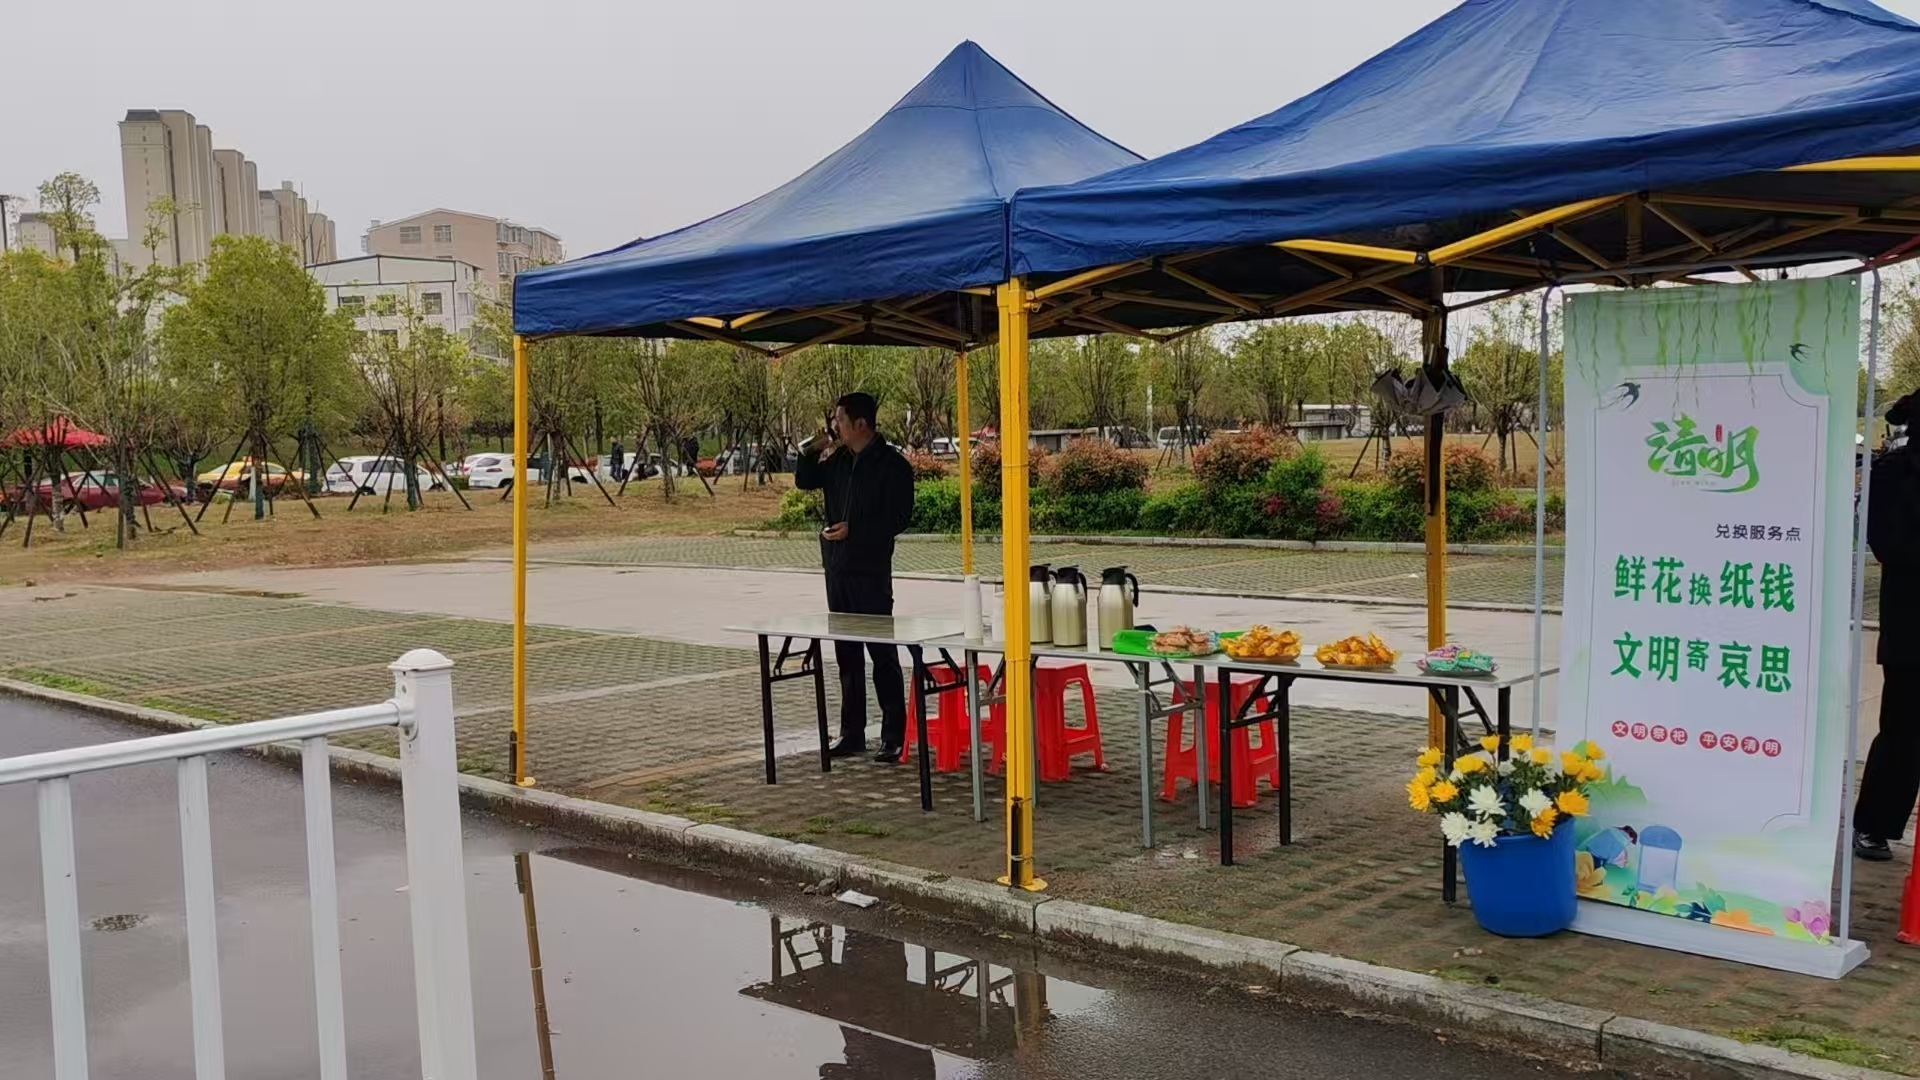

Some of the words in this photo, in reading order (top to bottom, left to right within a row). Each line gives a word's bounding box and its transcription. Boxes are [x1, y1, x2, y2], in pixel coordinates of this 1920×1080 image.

[1646, 412, 1760, 493] 清明
[1715, 524, 1801, 542] 兑换服务点
[1614, 555, 1795, 612] 鲜花换纸钱
[1611, 632, 1792, 693] 文明寄哀思
[1613, 721, 1687, 744] 文明祭祀
[1701, 732, 1780, 756] 平安清明
